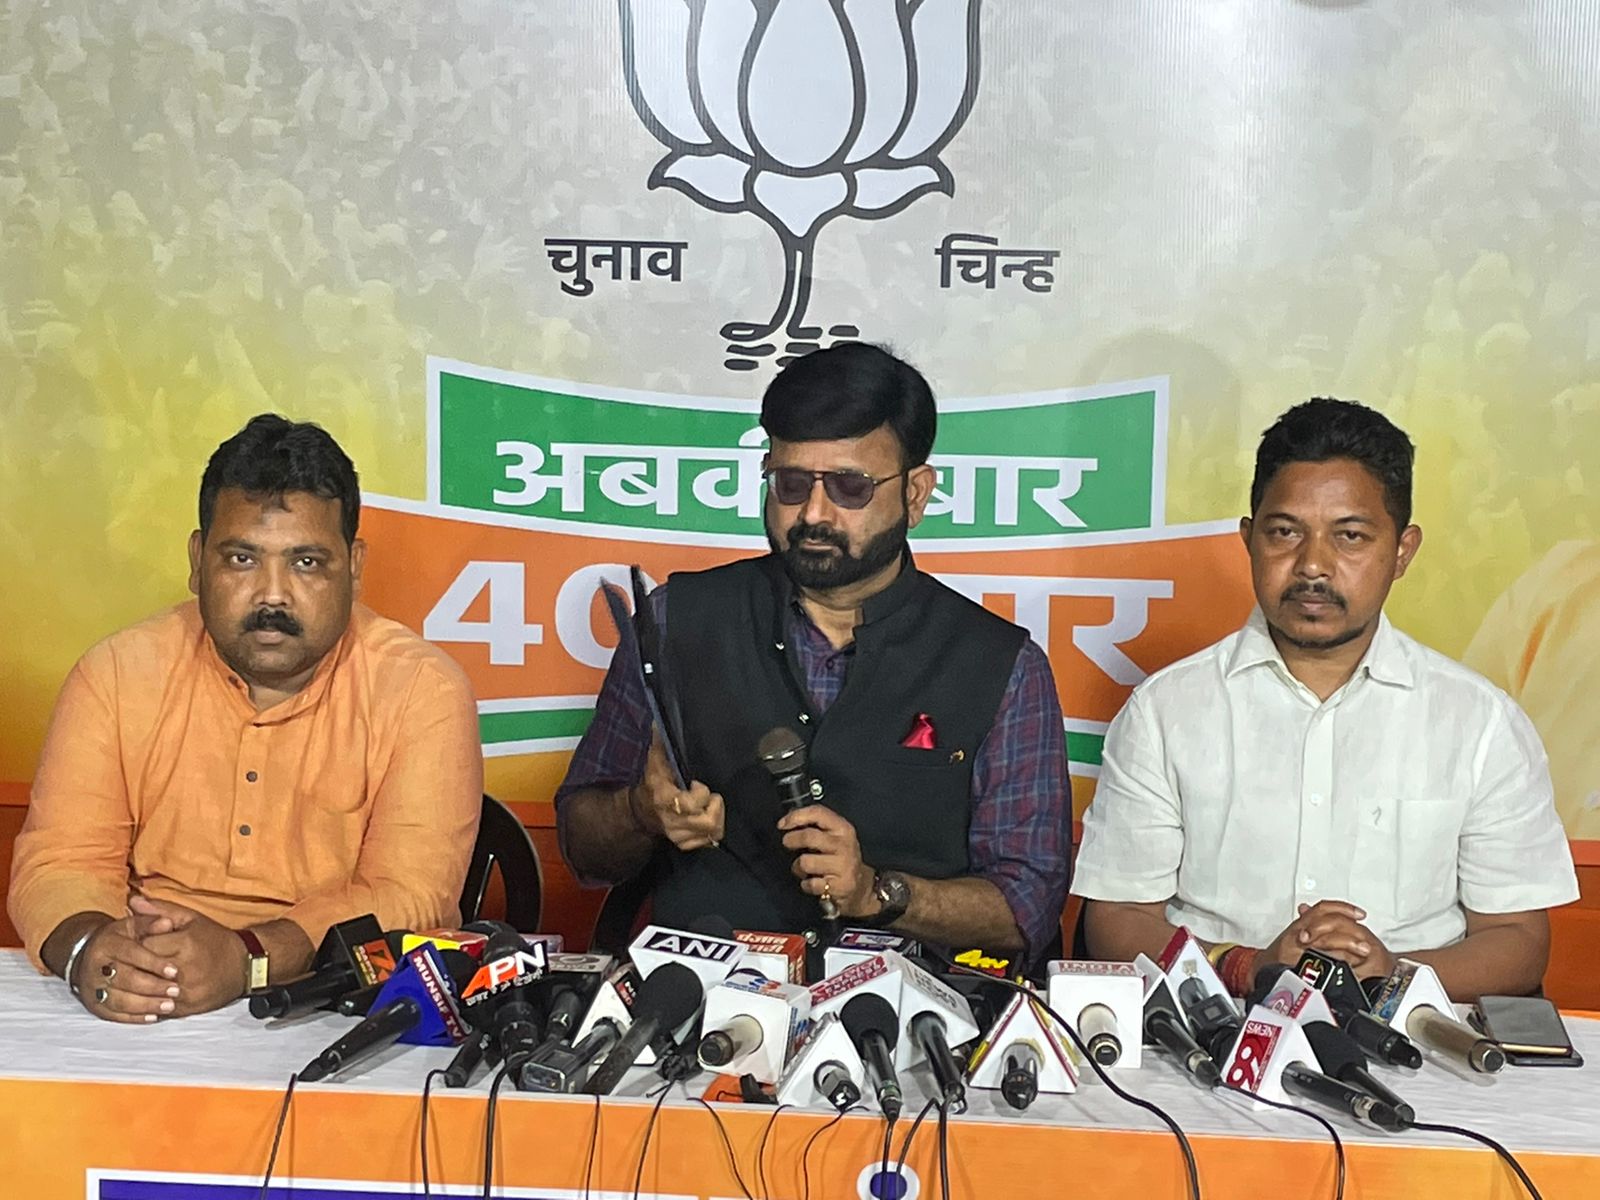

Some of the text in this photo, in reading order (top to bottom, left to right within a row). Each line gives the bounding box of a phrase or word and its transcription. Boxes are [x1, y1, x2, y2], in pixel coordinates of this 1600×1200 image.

[544, 233, 1061, 297] चुनाव चिन्ह
[423, 561, 1174, 685] 40 ार
[460, 943, 545, 1000] APN
[650, 935, 730, 960] ANI
[412, 956, 463, 1040] MUNSIF TV
[1246, 1020, 1276, 1038] NEWS
